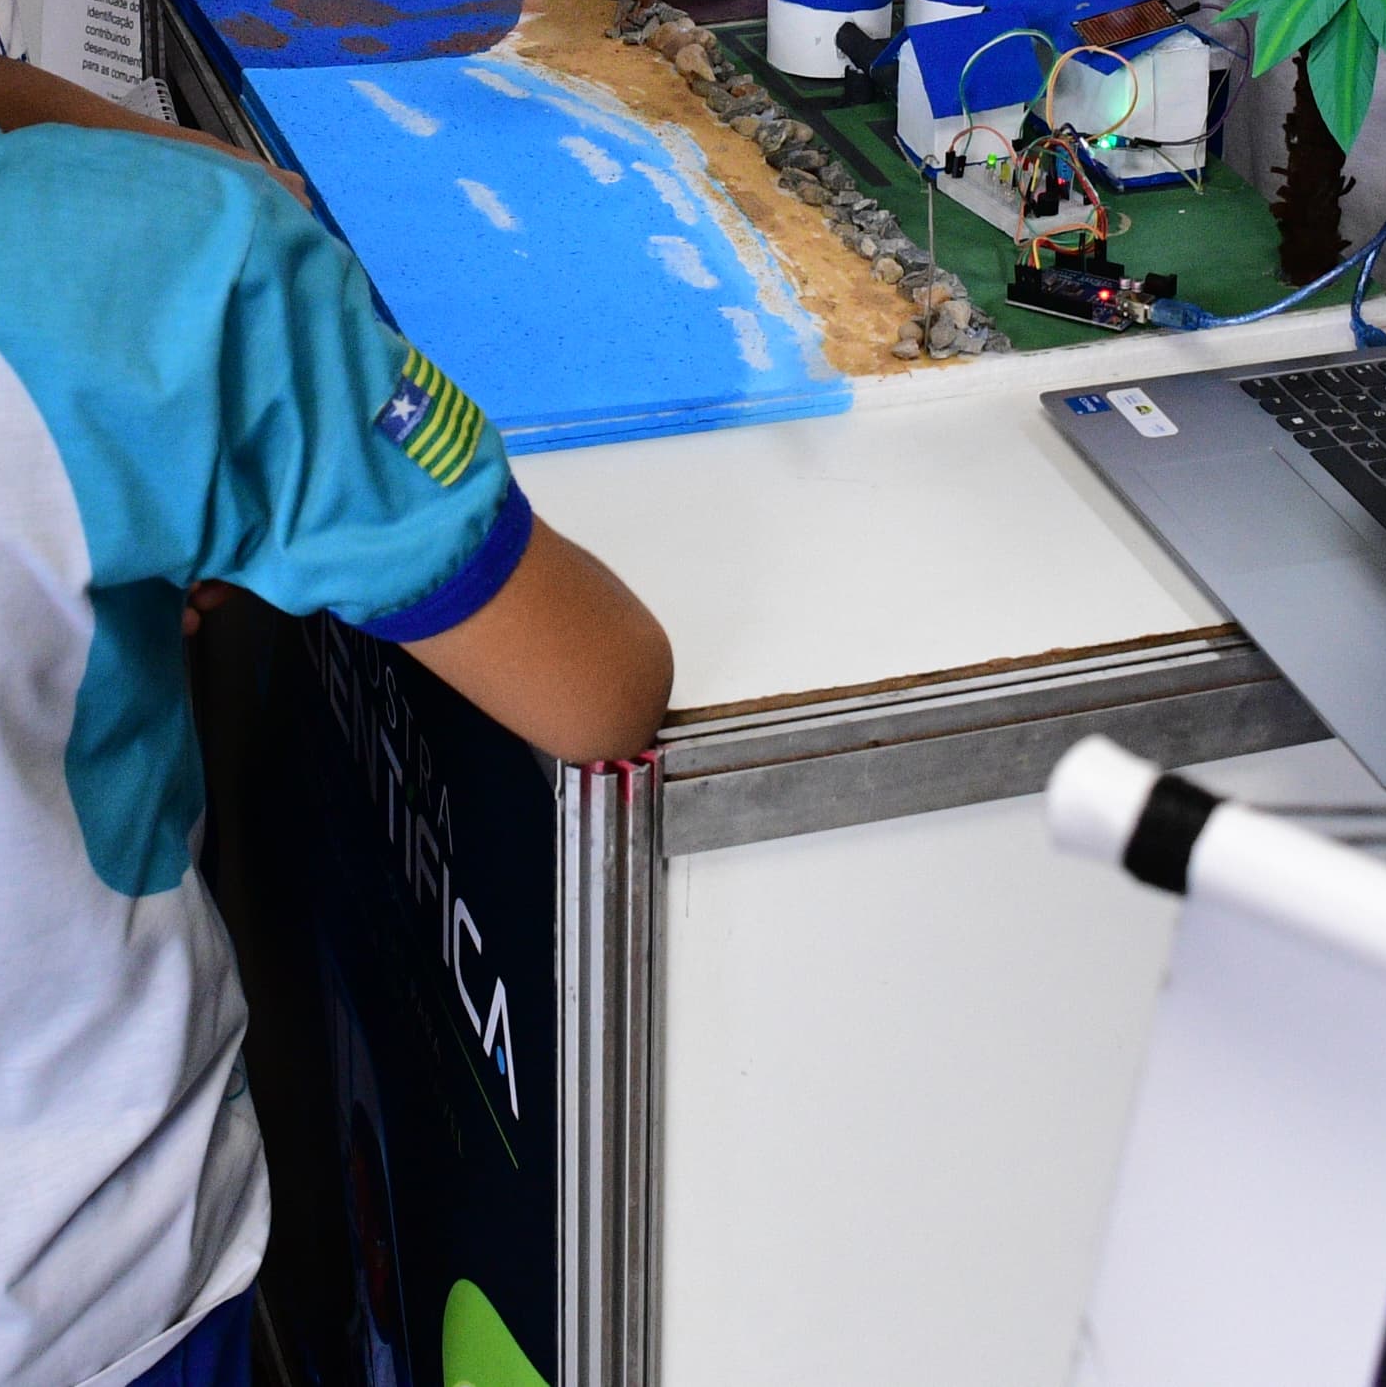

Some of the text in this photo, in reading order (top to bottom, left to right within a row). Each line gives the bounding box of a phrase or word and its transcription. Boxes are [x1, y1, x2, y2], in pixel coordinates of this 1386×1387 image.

[87, 5, 134, 30] identificação
[85, 24, 131, 47] contribuindo
[82, 59, 100, 74] para
[350, 625, 453, 857] OSTRA
